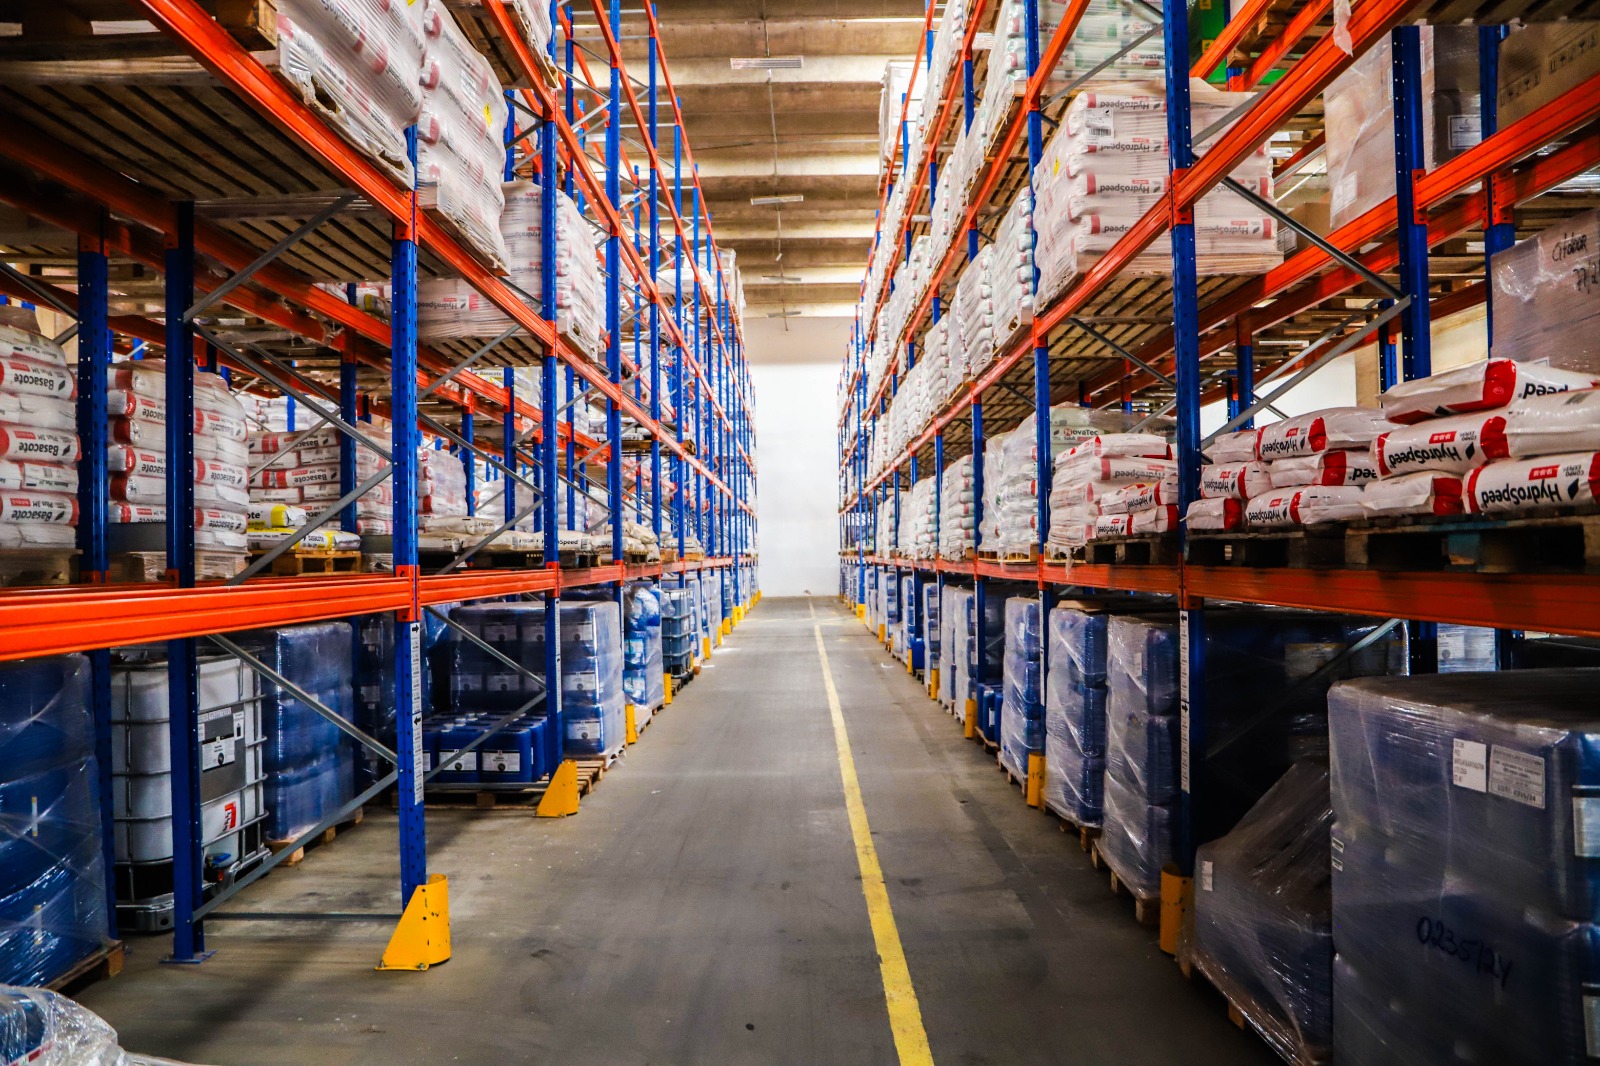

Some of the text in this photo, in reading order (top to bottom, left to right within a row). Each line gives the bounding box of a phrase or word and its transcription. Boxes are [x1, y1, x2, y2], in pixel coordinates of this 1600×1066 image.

[1100, 184, 1150, 194] HydroSpeed
[13, 373, 54, 390] Basacote
[1063, 428, 1098, 436] NovaTec
[18, 442, 59, 457] Basacote
[1261, 435, 1298, 456] HydroSpeed
[1388, 443, 1461, 468] HydroSpeed
[210, 472, 236, 484] Basacote
[293, 473, 328, 484] Basacote
[1480, 479, 1562, 508] HydroSpeed
[10, 510, 53, 523] Basacote
[1248, 507, 1282, 524] HydroSpeed
[208, 520, 234, 530] Basacote
[1416, 916, 1513, 988] 0235/24
